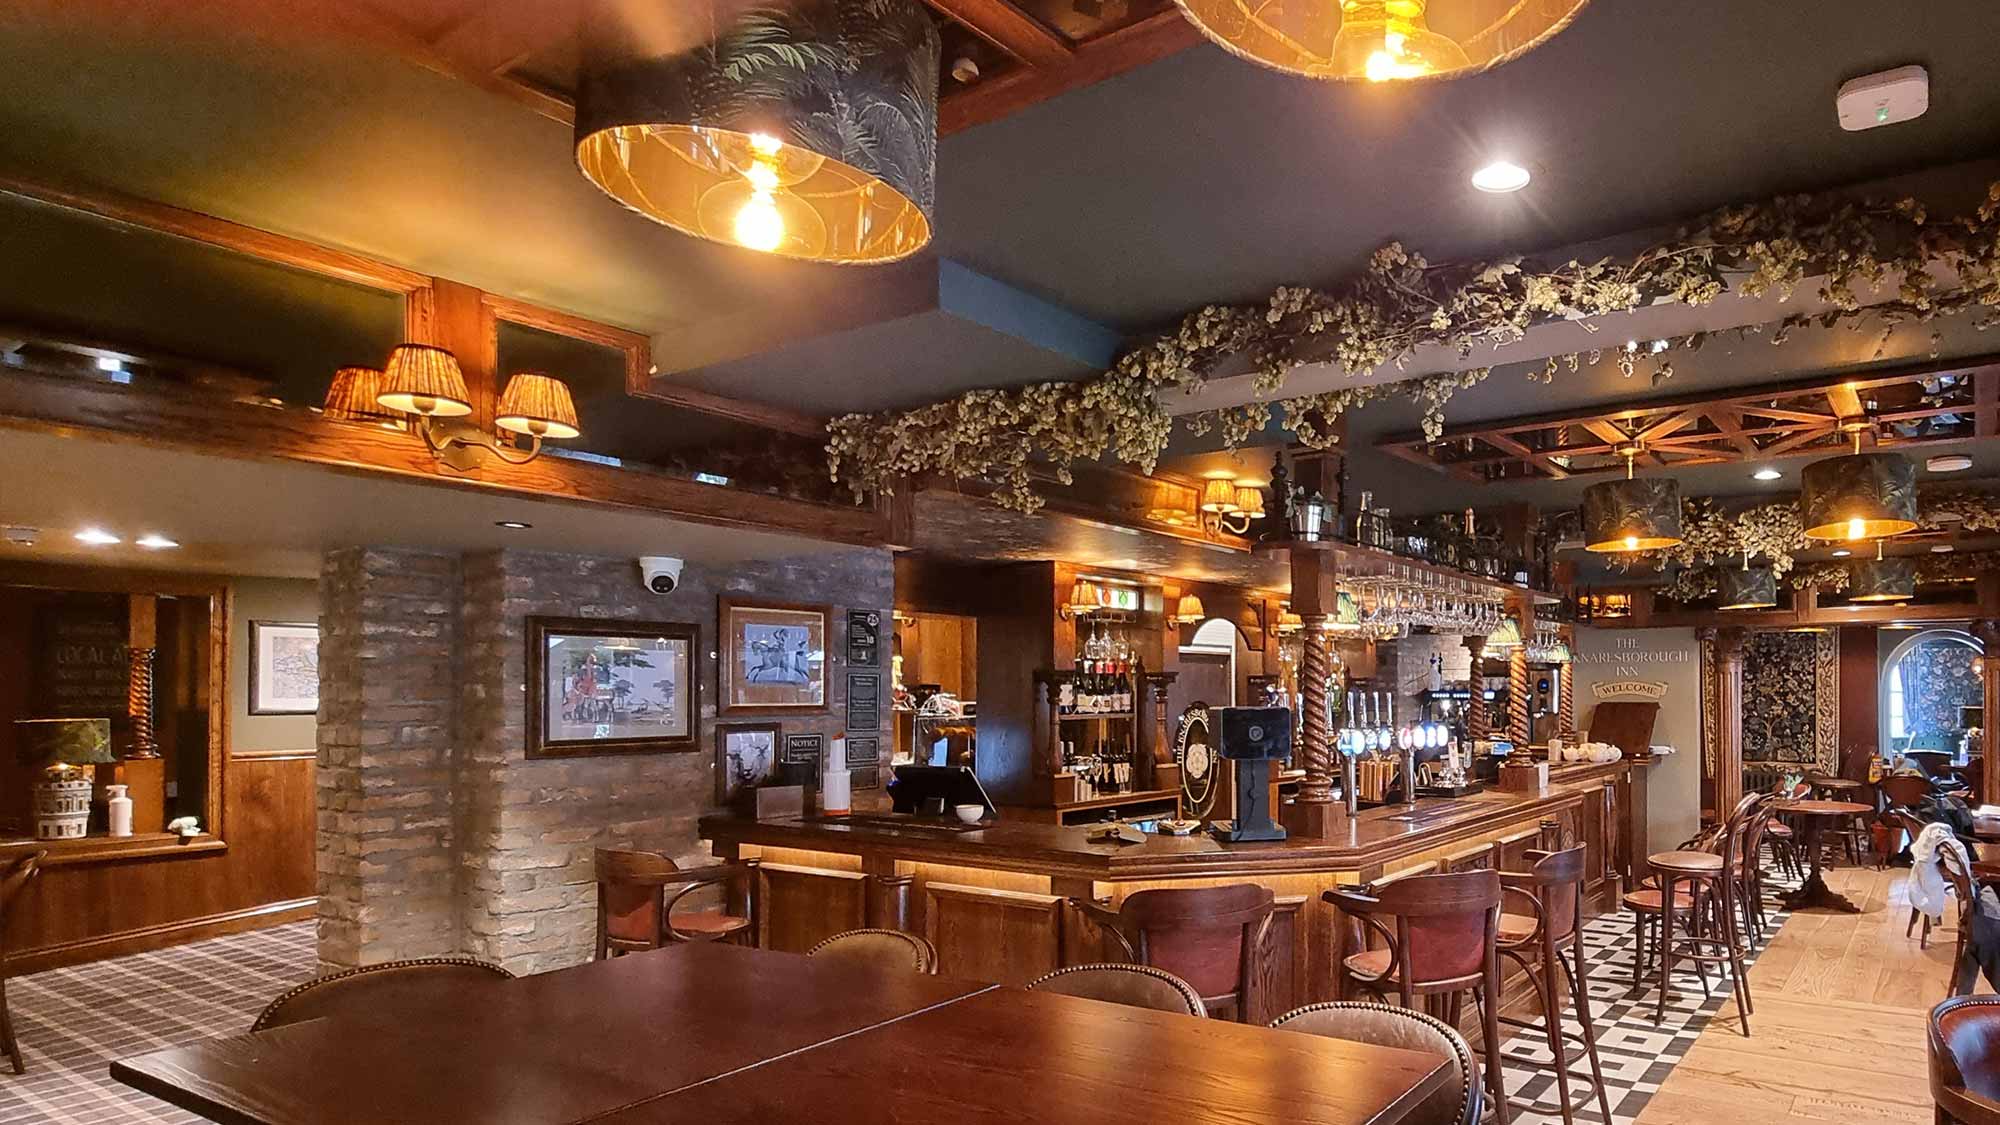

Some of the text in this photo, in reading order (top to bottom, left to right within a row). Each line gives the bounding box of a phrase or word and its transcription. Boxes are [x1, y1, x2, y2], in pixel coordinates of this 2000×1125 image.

[1615, 638, 1640, 649] THE
[1573, 650, 1688, 664] KNARESBOROUGH
[1616, 666, 1639, 677] INN
[1602, 682, 1657, 695] WELCOME
